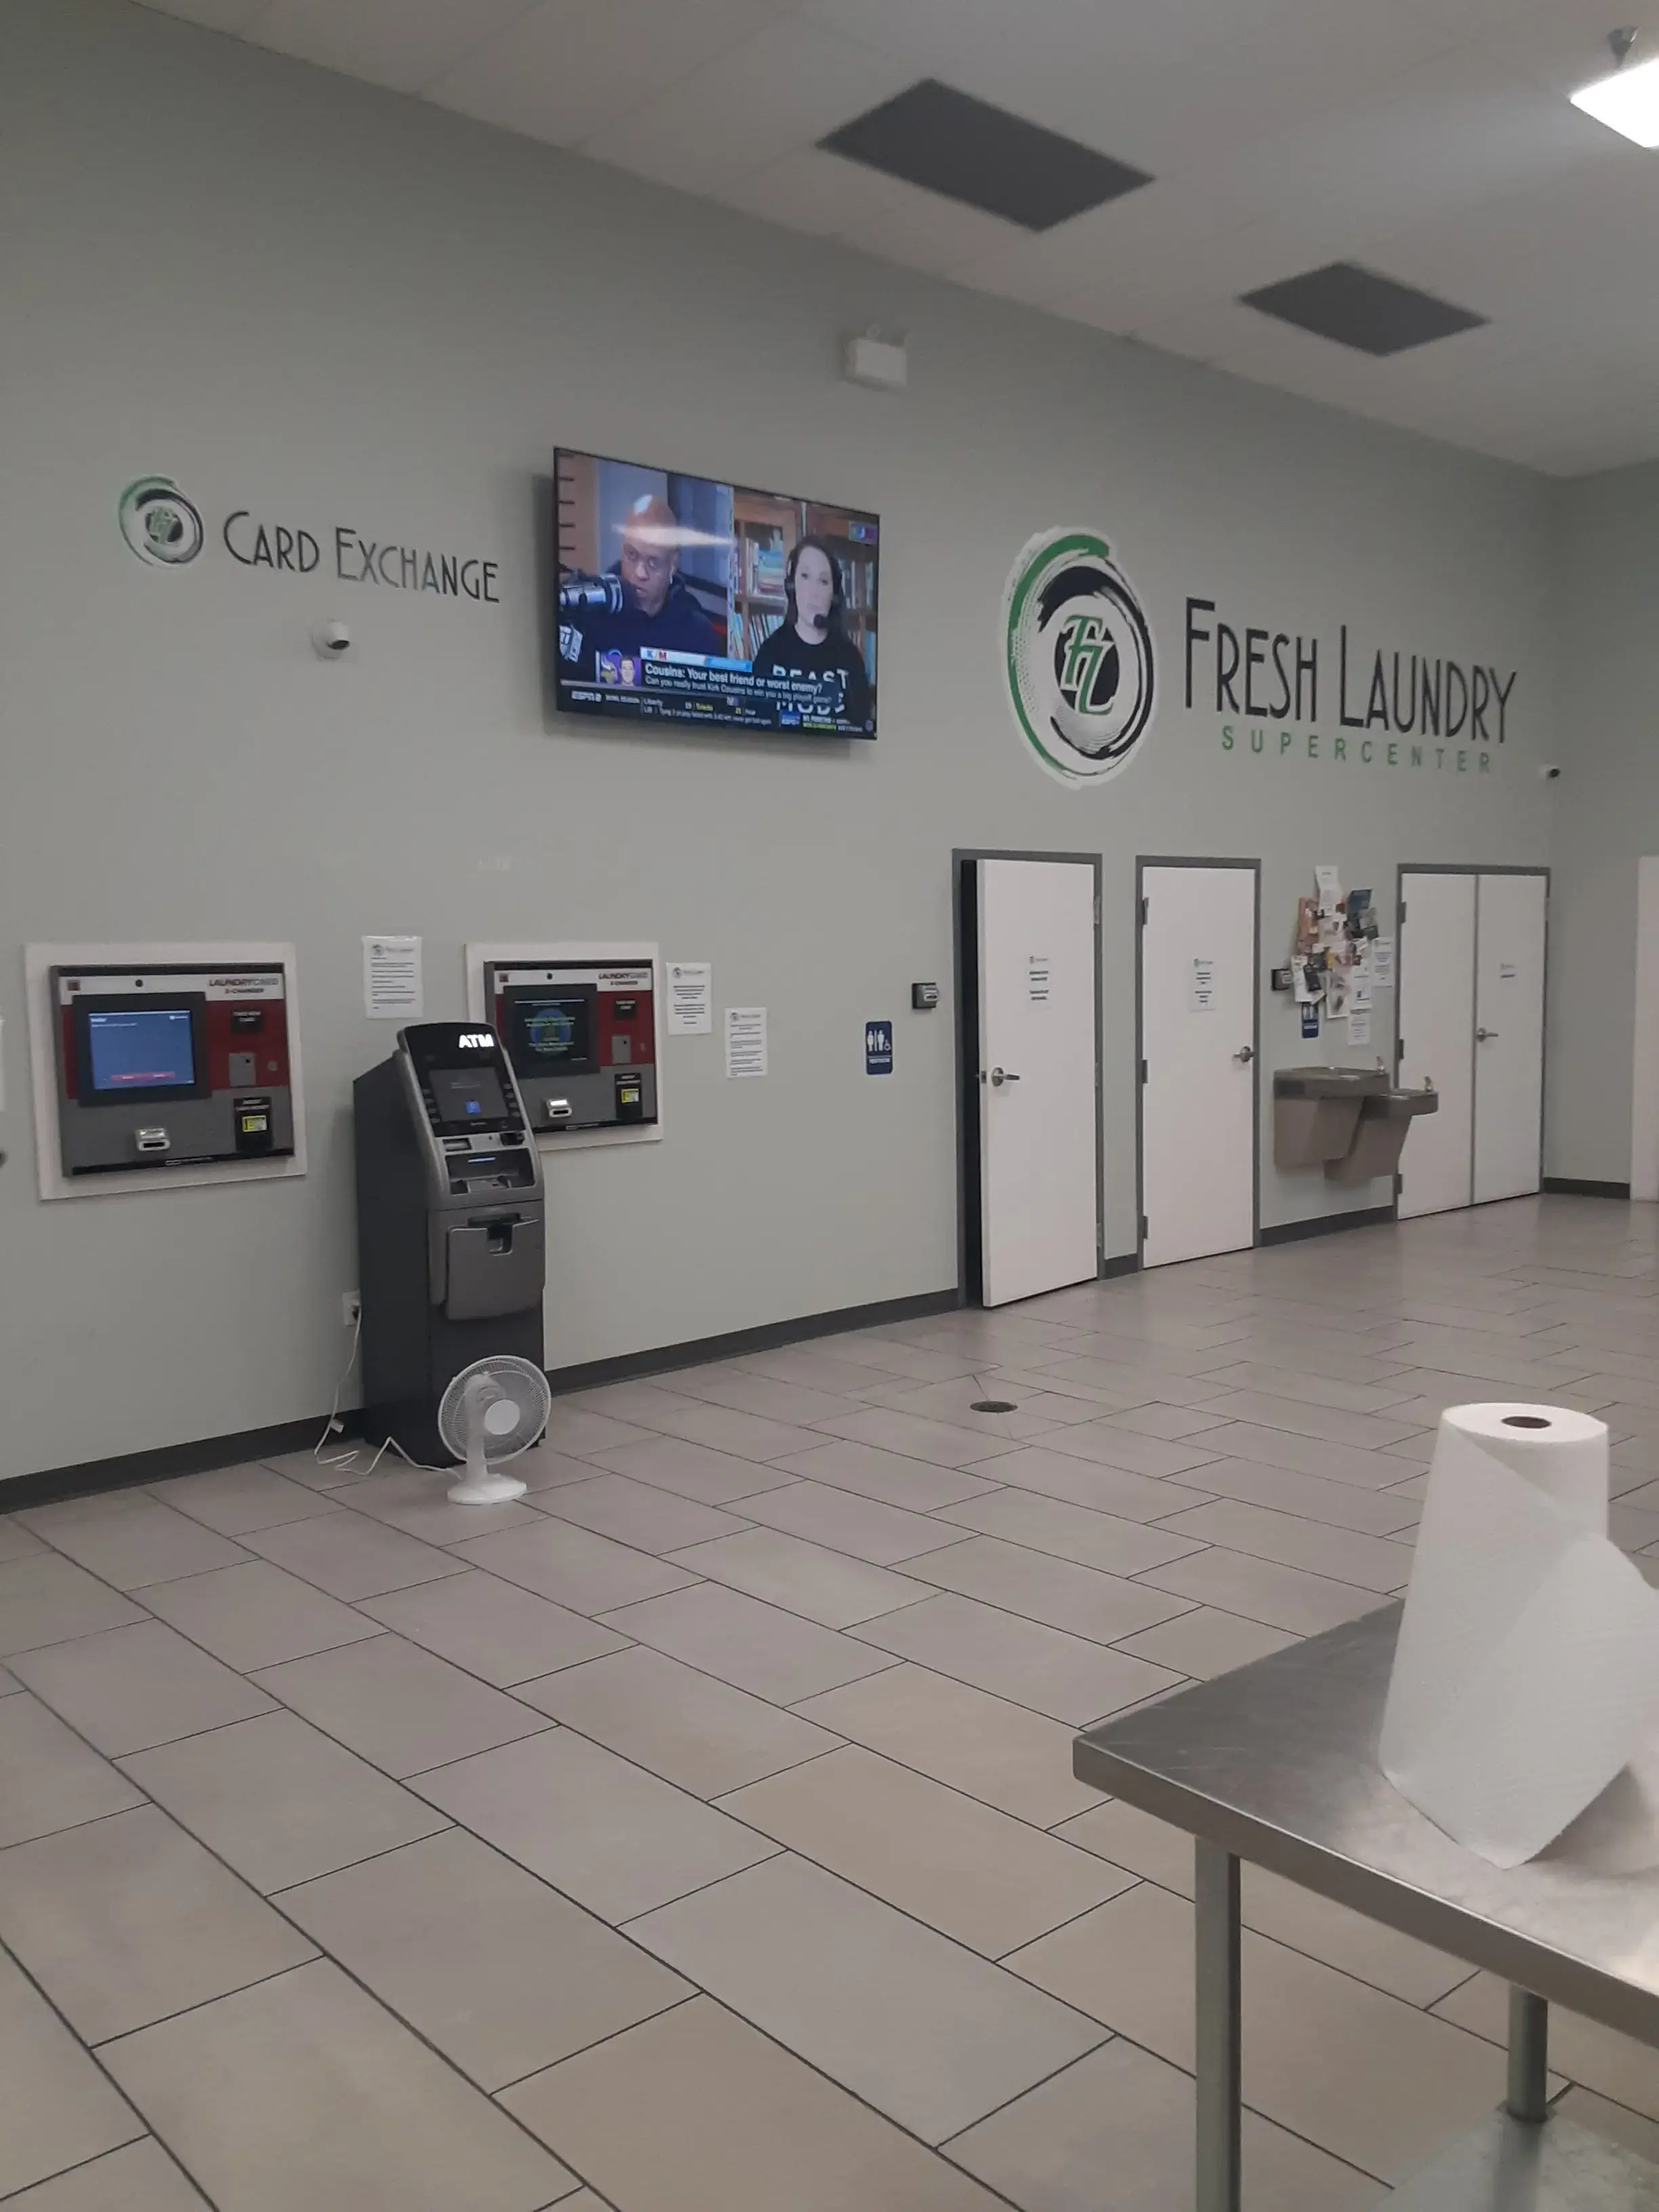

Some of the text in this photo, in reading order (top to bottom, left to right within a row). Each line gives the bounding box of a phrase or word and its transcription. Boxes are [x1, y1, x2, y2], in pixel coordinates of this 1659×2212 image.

[645, 662, 823, 695] Cousins: Your best friend or worst enemy?
[1185, 596, 1517, 744] FRESH LAUNDRY
[1221, 725, 1492, 775] SUPERCENTER
[458, 1033, 495, 1048] ATM
